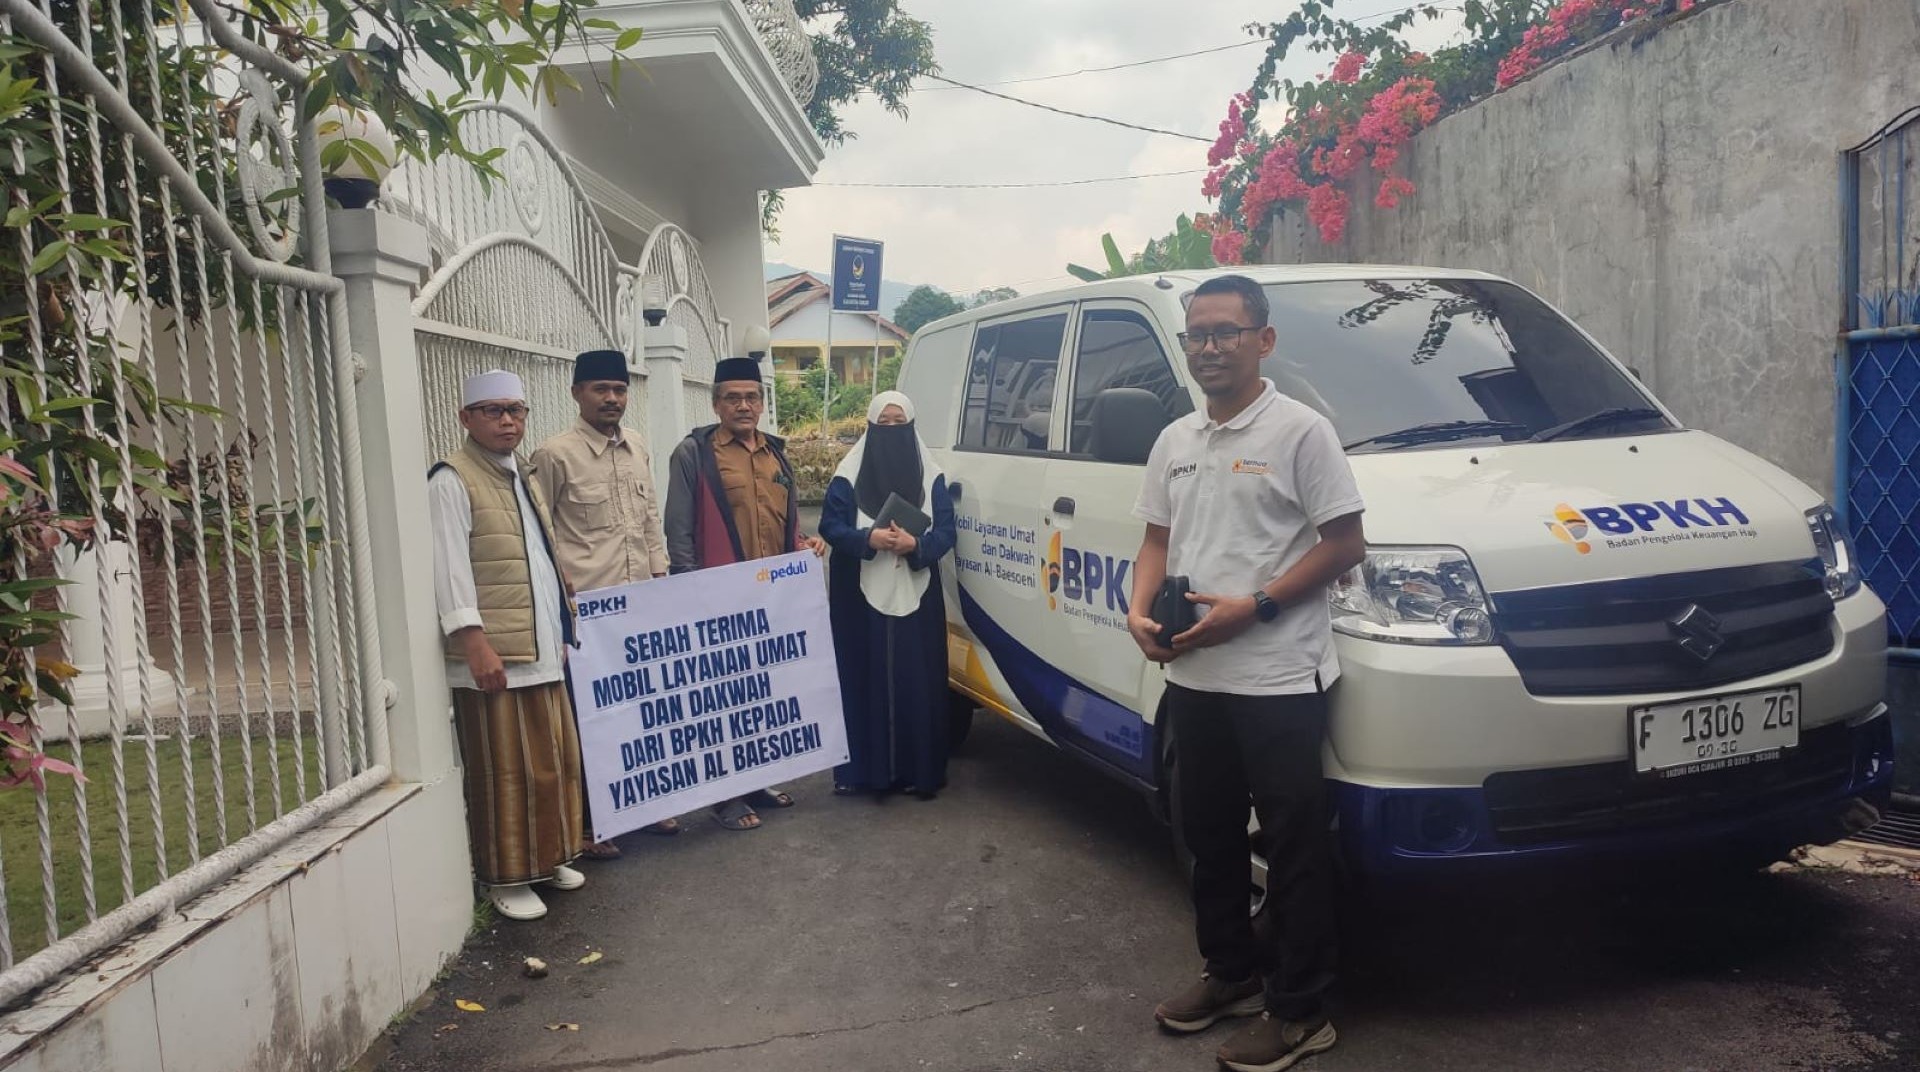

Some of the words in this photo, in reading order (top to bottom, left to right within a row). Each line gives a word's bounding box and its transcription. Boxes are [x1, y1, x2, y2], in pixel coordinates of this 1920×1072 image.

[975, 518, 1007, 538] Layanan
[1010, 525, 1035, 544] Umat
[1581, 497, 1749, 534] BPKH
[1607, 539, 1640, 549] Badan
[1642, 532, 1690, 544] Pengelola
[756, 560, 808, 584] dtpeduli
[981, 539, 997, 556] dan
[999, 544, 1035, 566] Dakwah
[578, 595, 626, 617] BPKH
[1062, 547, 1136, 616] BPK
[624, 624, 692, 664] SERAH
[695, 608, 770, 648] TERIMA
[592, 667, 656, 708] MOBIL
[660, 645, 751, 690] LAYANAN
[755, 630, 807, 668] UMAT
[639, 694, 684, 730] DAN
[688, 672, 772, 718] DAKWAH
[1638, 713, 1655, 750] F
[1681, 702, 1744, 743] 1306
[1762, 694, 1795, 731] ZG
[620, 732, 666, 772] DARI
[669, 716, 724, 756] BPKH
[729, 696, 802, 739] KEPADA
[608, 758, 698, 811] YAYASAN
[704, 749, 728, 782] AL
[732, 723, 822, 772] BAESOENI
